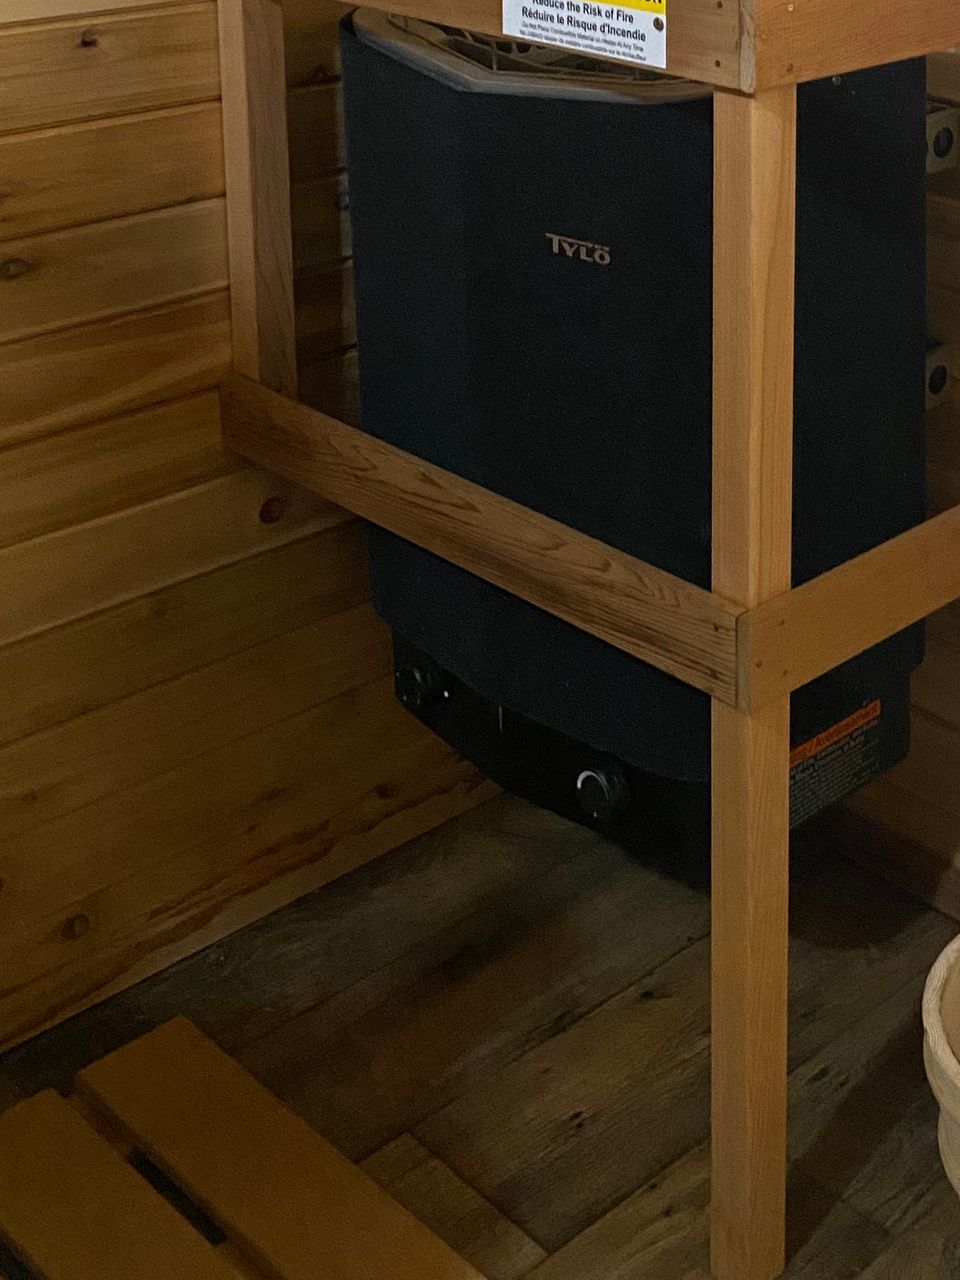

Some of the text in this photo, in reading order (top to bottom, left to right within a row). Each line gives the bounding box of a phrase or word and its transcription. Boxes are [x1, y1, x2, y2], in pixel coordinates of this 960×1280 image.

[521, 5, 554, 23] Réduire
[556, 13, 564, 25] le
[566, 14, 597, 32] Risque
[599, 22, 645, 42] d'Incendie
[566, 0, 580, 13] the
[582, 2, 602, 18] Risk
[604, 8, 614, 20] of
[616, 9, 633, 24] Fire
